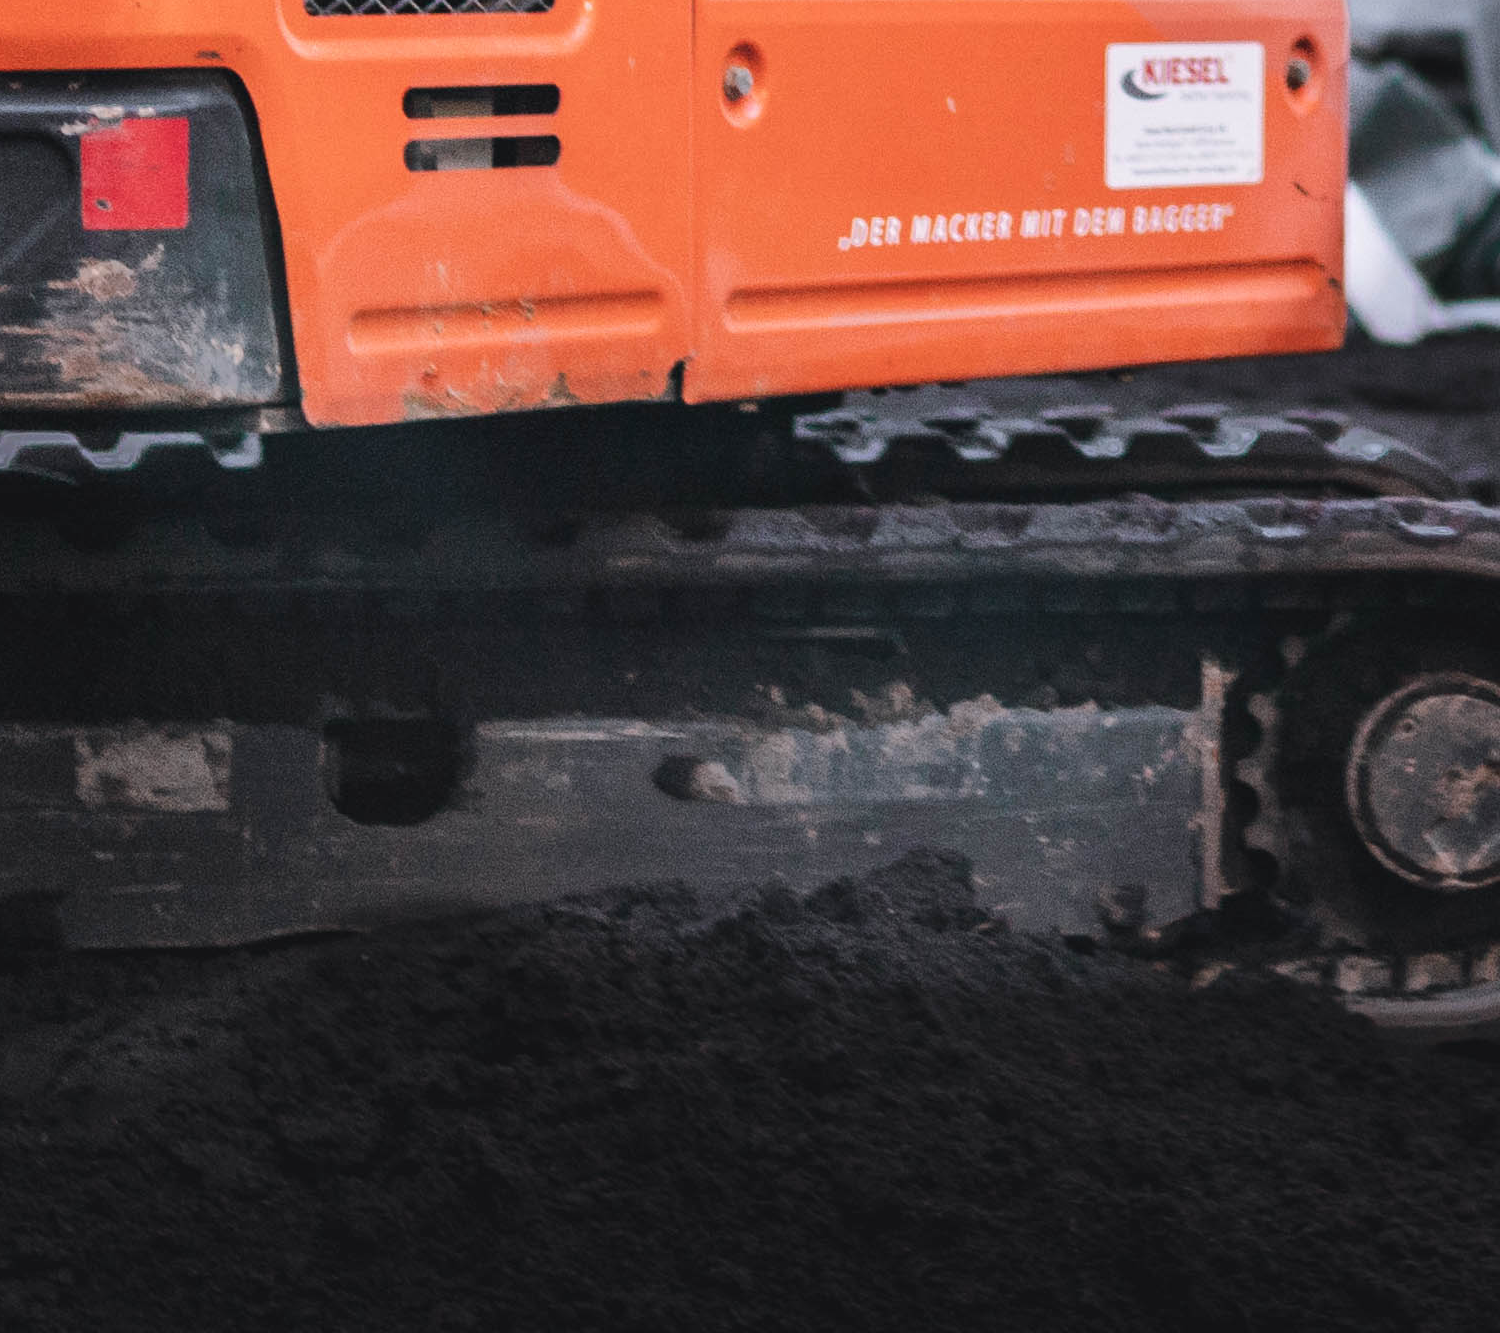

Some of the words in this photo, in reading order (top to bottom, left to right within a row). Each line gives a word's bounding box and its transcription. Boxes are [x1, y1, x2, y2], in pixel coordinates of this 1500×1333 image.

[911, 211, 1011, 245] MACKER
[1020, 208, 1067, 239] MIT
[1073, 206, 1125, 236] DEM
